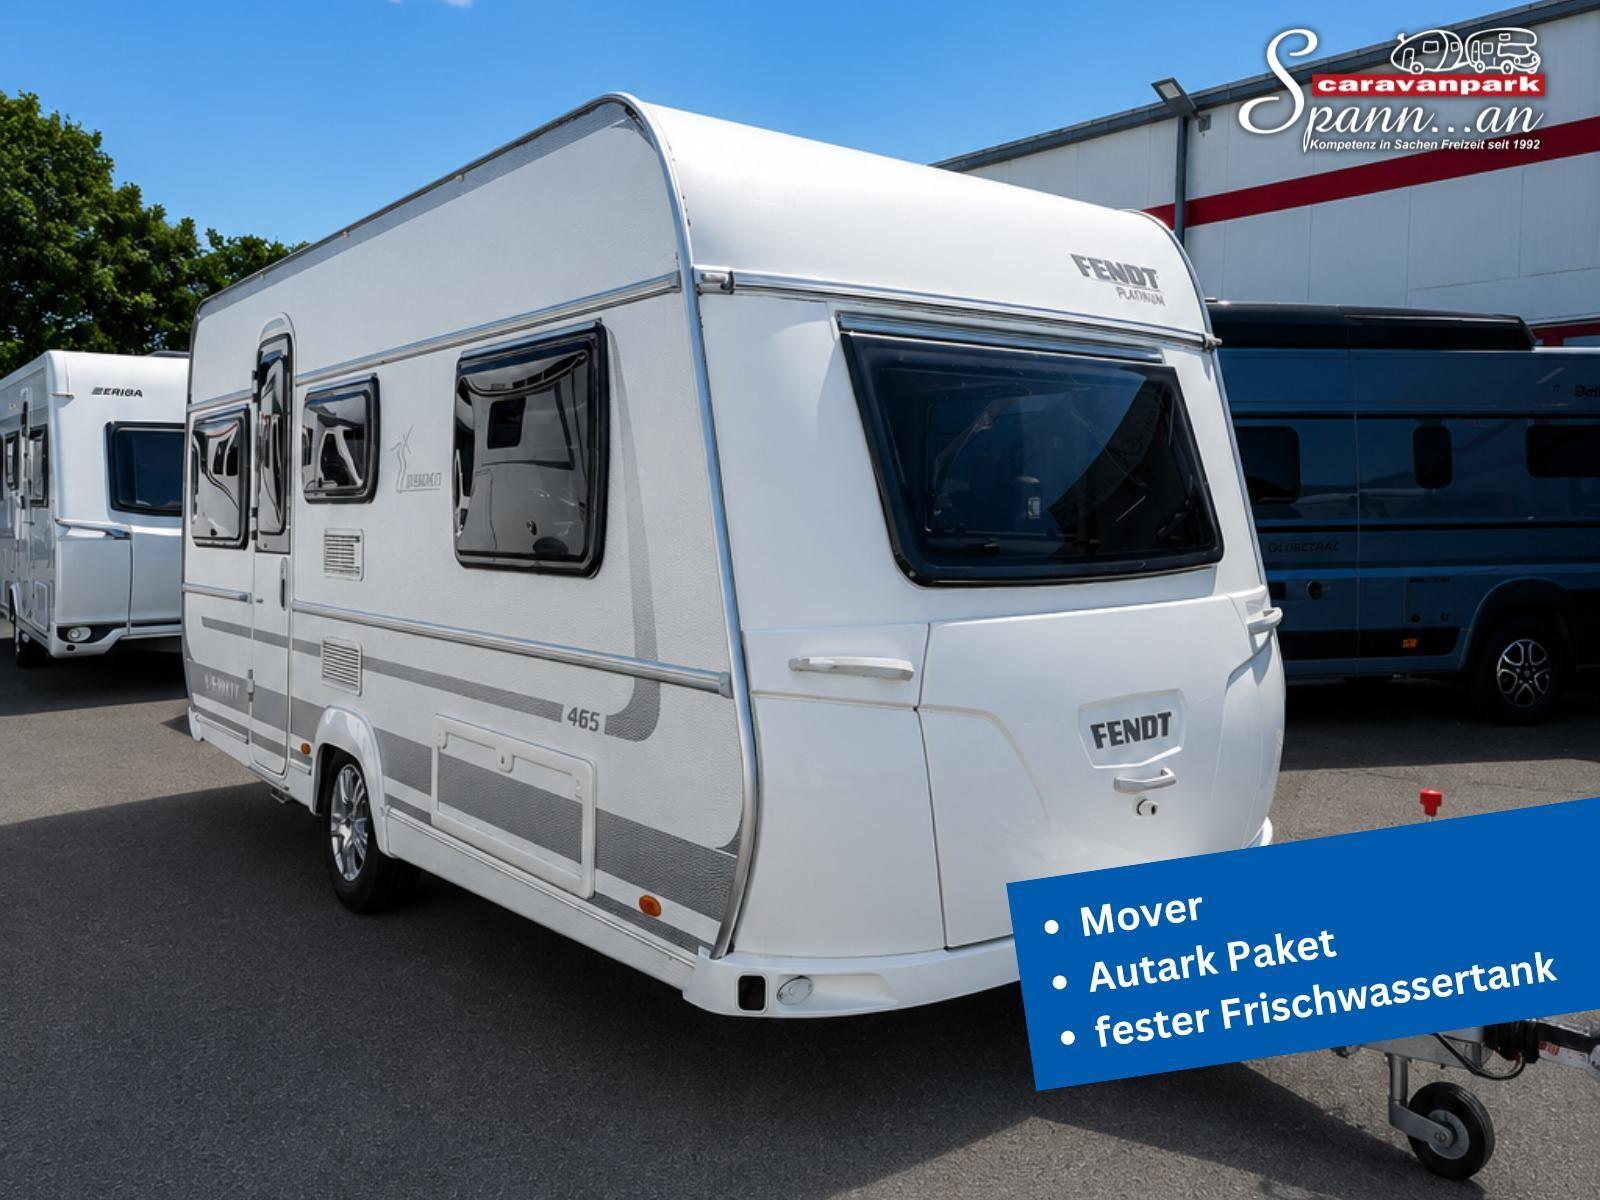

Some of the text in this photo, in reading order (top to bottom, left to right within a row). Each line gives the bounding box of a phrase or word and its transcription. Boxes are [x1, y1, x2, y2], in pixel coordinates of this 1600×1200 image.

[1070, 253, 1158, 289] FENDT
[567, 707, 600, 732] 465
[1090, 711, 1172, 749] FENDT
